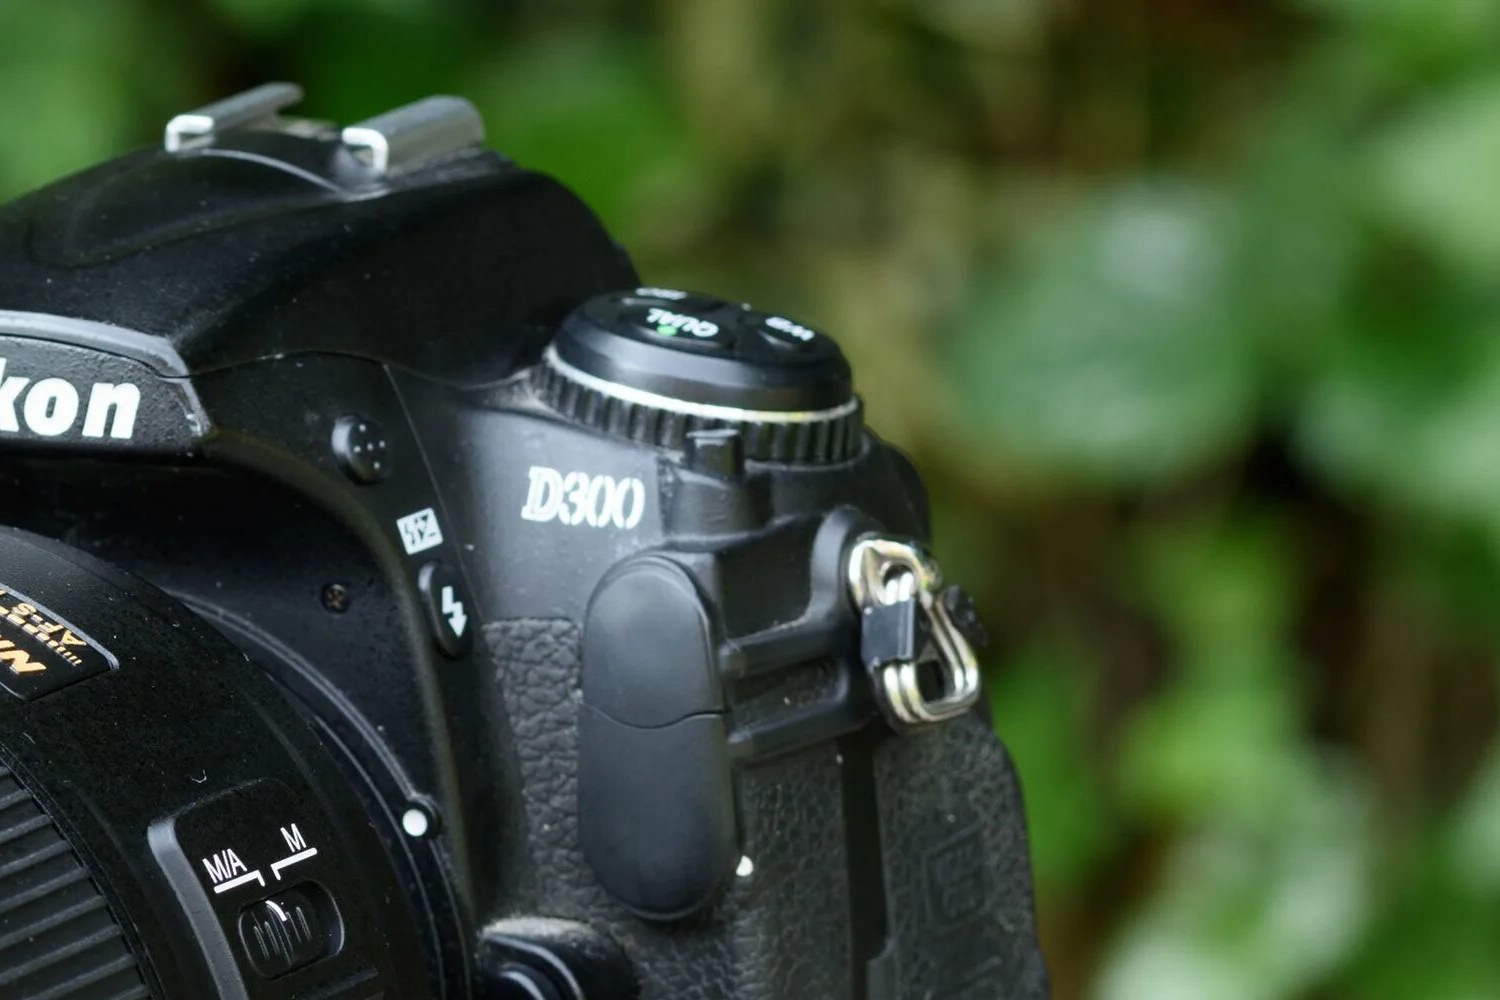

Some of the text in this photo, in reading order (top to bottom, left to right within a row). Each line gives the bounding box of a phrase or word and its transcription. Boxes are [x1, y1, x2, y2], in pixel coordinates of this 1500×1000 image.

[521, 465, 646, 530] D300
[11, 602, 87, 647] AF-S
[202, 823, 307, 885] M/A M
